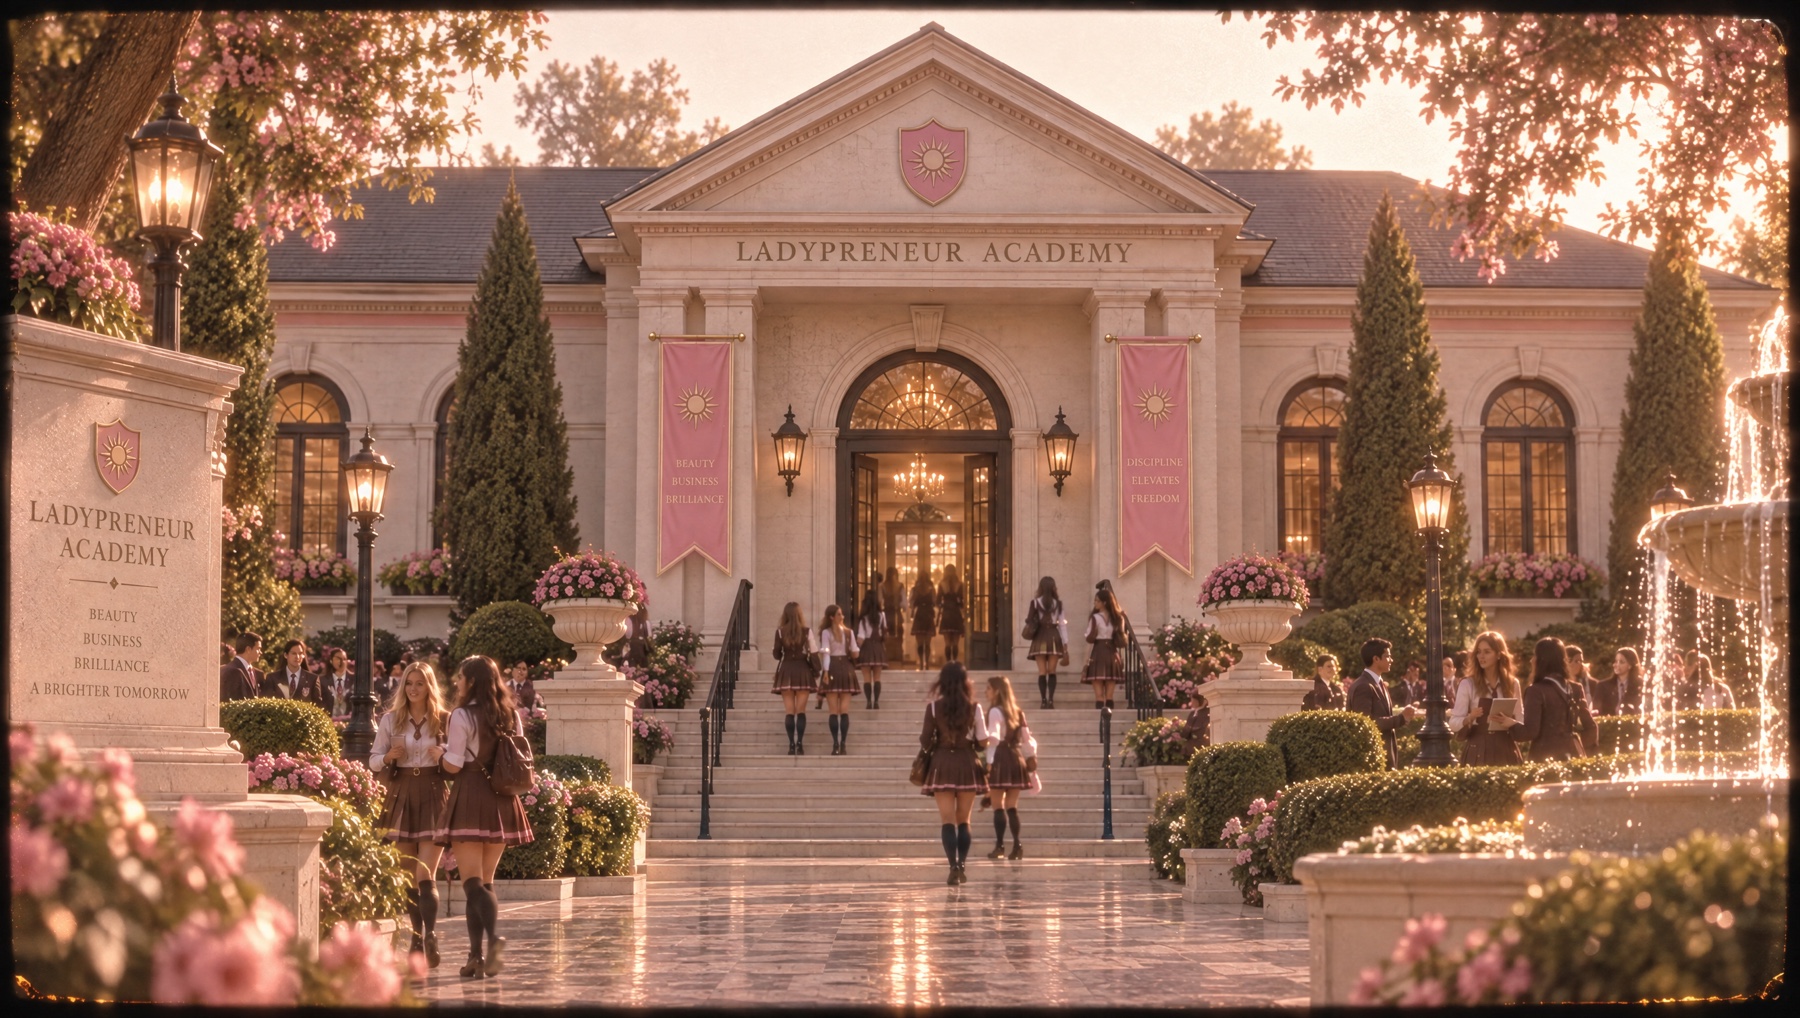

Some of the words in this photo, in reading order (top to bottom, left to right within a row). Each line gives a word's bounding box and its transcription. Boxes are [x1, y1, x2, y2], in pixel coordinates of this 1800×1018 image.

[737, 241, 963, 262] LADYPRENEUR
[982, 242, 1132, 263] ACADEMY
[676, 459, 715, 468] BEAUTY
[1127, 458, 1183, 467] DISCIPLINE
[672, 477, 718, 486] BUSINESS
[1132, 476, 1180, 485] ELEVATES
[666, 495, 724, 504] BRILLIANCE
[1131, 494, 1180, 503] FREEDOM
[29, 500, 195, 540] LADYPRENEUR
[60, 537, 169, 567] ACADEMY
[89, 608, 138, 623] BEAUTY
[83, 633, 142, 648] BUSINESS
[74, 657, 150, 673] BRILLIANCE
[30, 682, 40, 695] A
[44, 683, 110, 698] BRIGHTER
[114, 686, 190, 700] TOMORROW
